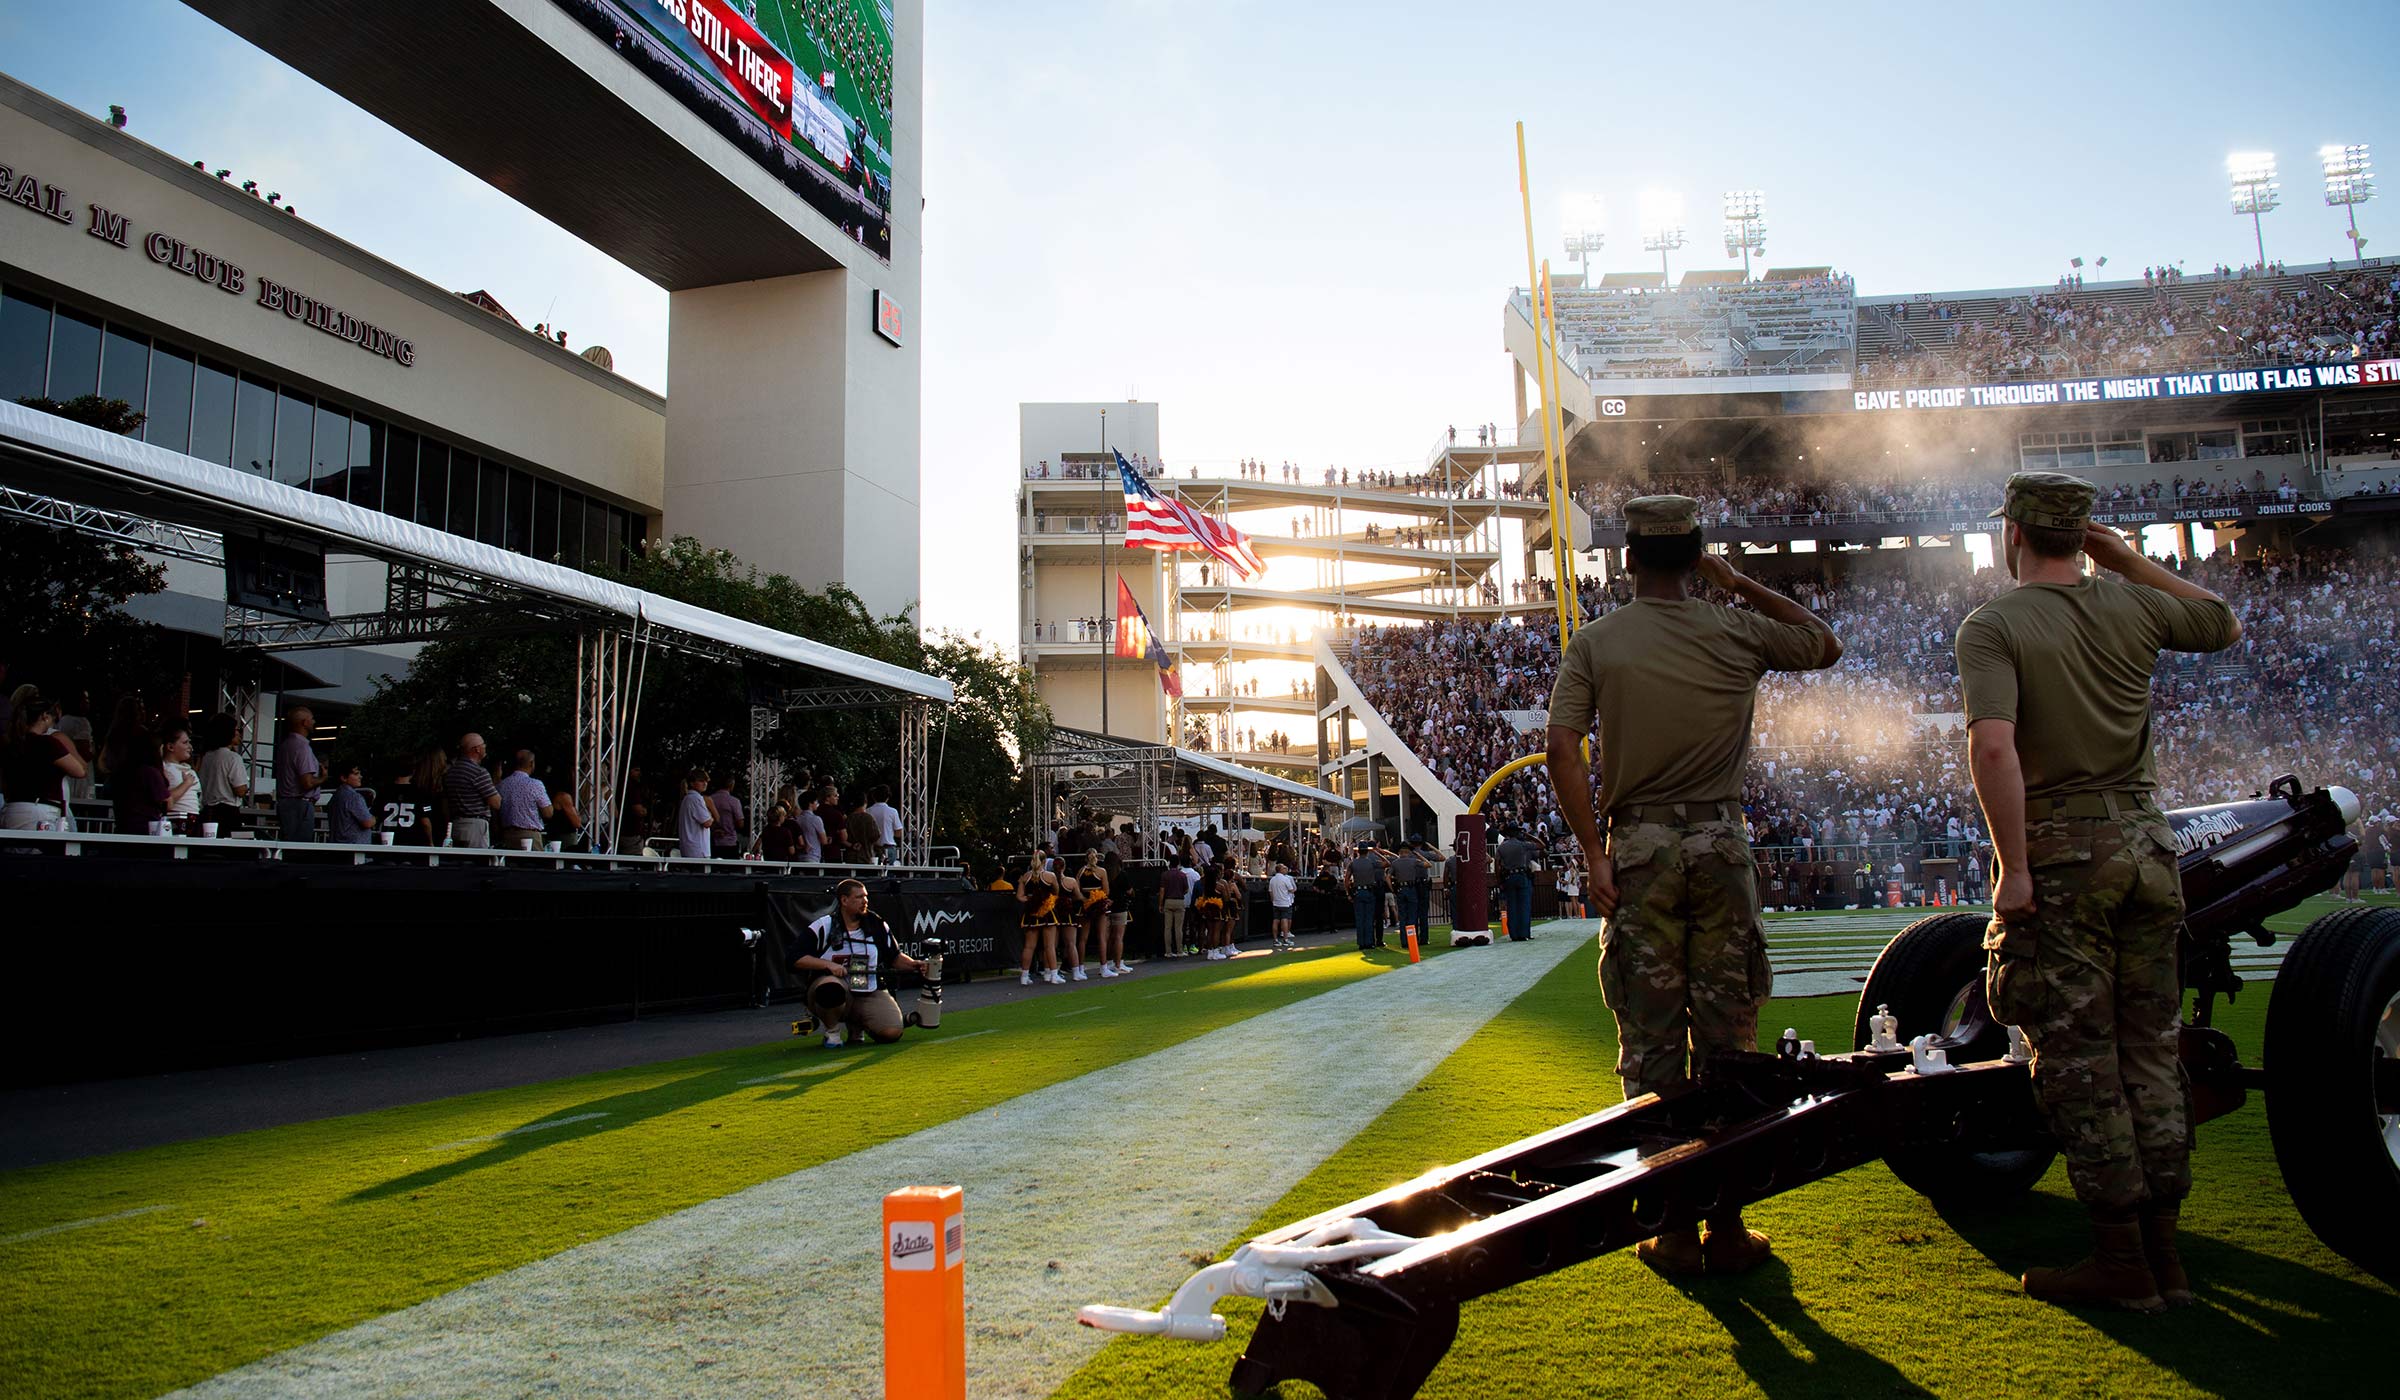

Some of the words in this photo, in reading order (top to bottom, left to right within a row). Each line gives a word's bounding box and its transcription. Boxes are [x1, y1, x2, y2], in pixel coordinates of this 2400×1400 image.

[691, 0, 733, 66] STILL
[737, 38, 785, 114] THERE,
[87, 204, 132, 248] M
[144, 231, 247, 294] CLUB
[257, 276, 416, 367] BUILDING
[1854, 390, 1901, 410] GAVE
[1905, 387, 1965, 408] PROOF
[1970, 383, 2058, 406] THROUGH
[2062, 381, 2100, 401] THE
[2103, 377, 2160, 399] NIGHT
[2165, 374, 2213, 395] THAT
[2217, 370, 2259, 392] OUR
[2263, 367, 2313, 389] FLAG
[2315, 363, 2361, 385] WAS
[1604, 402, 1624, 414] CC
[2174, 509, 2199, 520] JACK
[2202, 507, 2242, 518] CRISTIL
[2257, 504, 2295, 515] JOHNIE
[2299, 502, 2332, 513] COOKS
[2051, 516, 2080, 529] CADET
[2118, 511, 2158, 522] PARKER
[1950, 521, 1968, 532] JOE
[1528, 711, 1543, 721] 02
[384, 802, 415, 828] 25
[959, 938, 994, 954] RESORT
[892, 1232, 930, 1256] State
